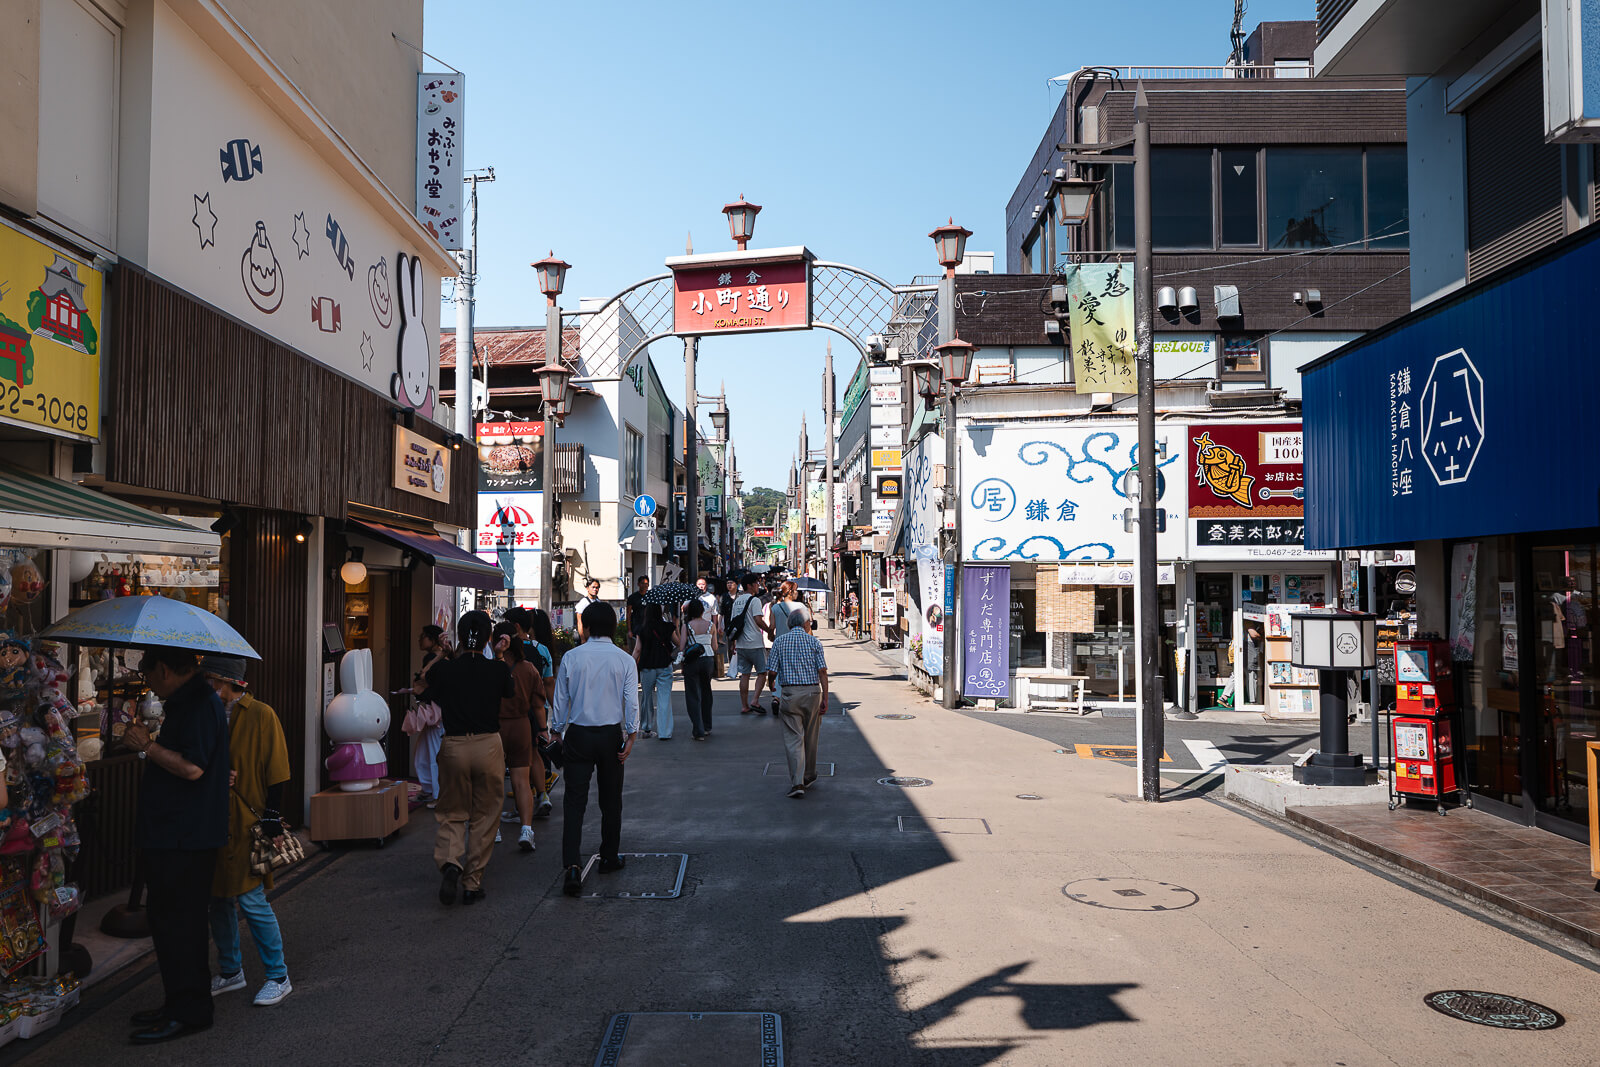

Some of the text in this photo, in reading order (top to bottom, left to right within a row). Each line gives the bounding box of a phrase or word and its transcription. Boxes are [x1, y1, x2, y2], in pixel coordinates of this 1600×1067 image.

[424, 128, 443, 199] おやつ堂
[718, 270, 762, 286] 鎌倉
[691, 285, 790, 315] 小町通り
[1077, 291, 1105, 327] 愛
[713, 317, 766, 328] KOMACHI ST.
[1389, 372, 1399, 497] KAMAKURA HACHIZA
[1397, 366, 1413, 496] 鎌倉八座
[635, 519, 655, 528] 12-16
[1024, 498, 1080, 523] 鎌倉
[979, 571, 995, 665] ずんだ専門店
